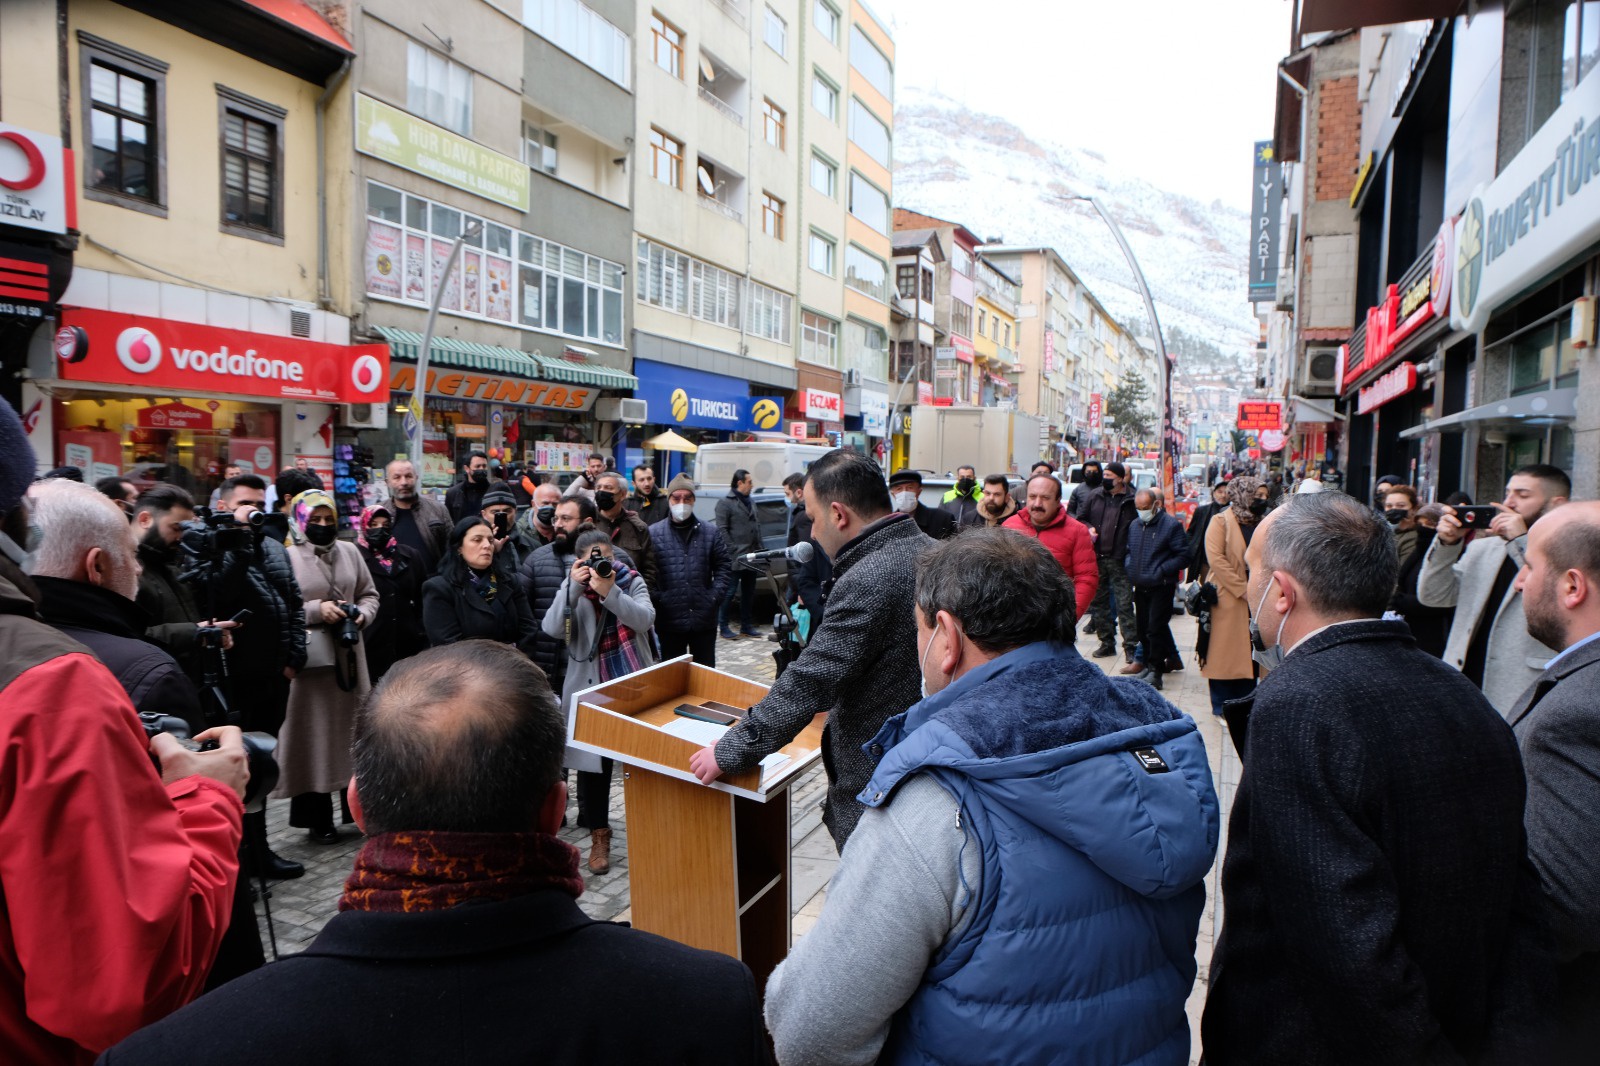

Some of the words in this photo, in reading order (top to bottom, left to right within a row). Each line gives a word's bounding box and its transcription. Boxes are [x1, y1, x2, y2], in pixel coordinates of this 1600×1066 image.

[409, 122, 440, 155] HÜR
[443, 137, 477, 169] DAVA
[6, 194, 31, 206] TÜRK
[29, 307, 41, 317] 50
[170, 346, 304, 381] vodafone
[690, 397, 738, 421] TURKCELL
[809, 393, 838, 411] ECZANE
[169, 409, 201, 419] Vodafone
[1091, 403, 1099, 427] CHP
[794, 427, 802, 436] E
